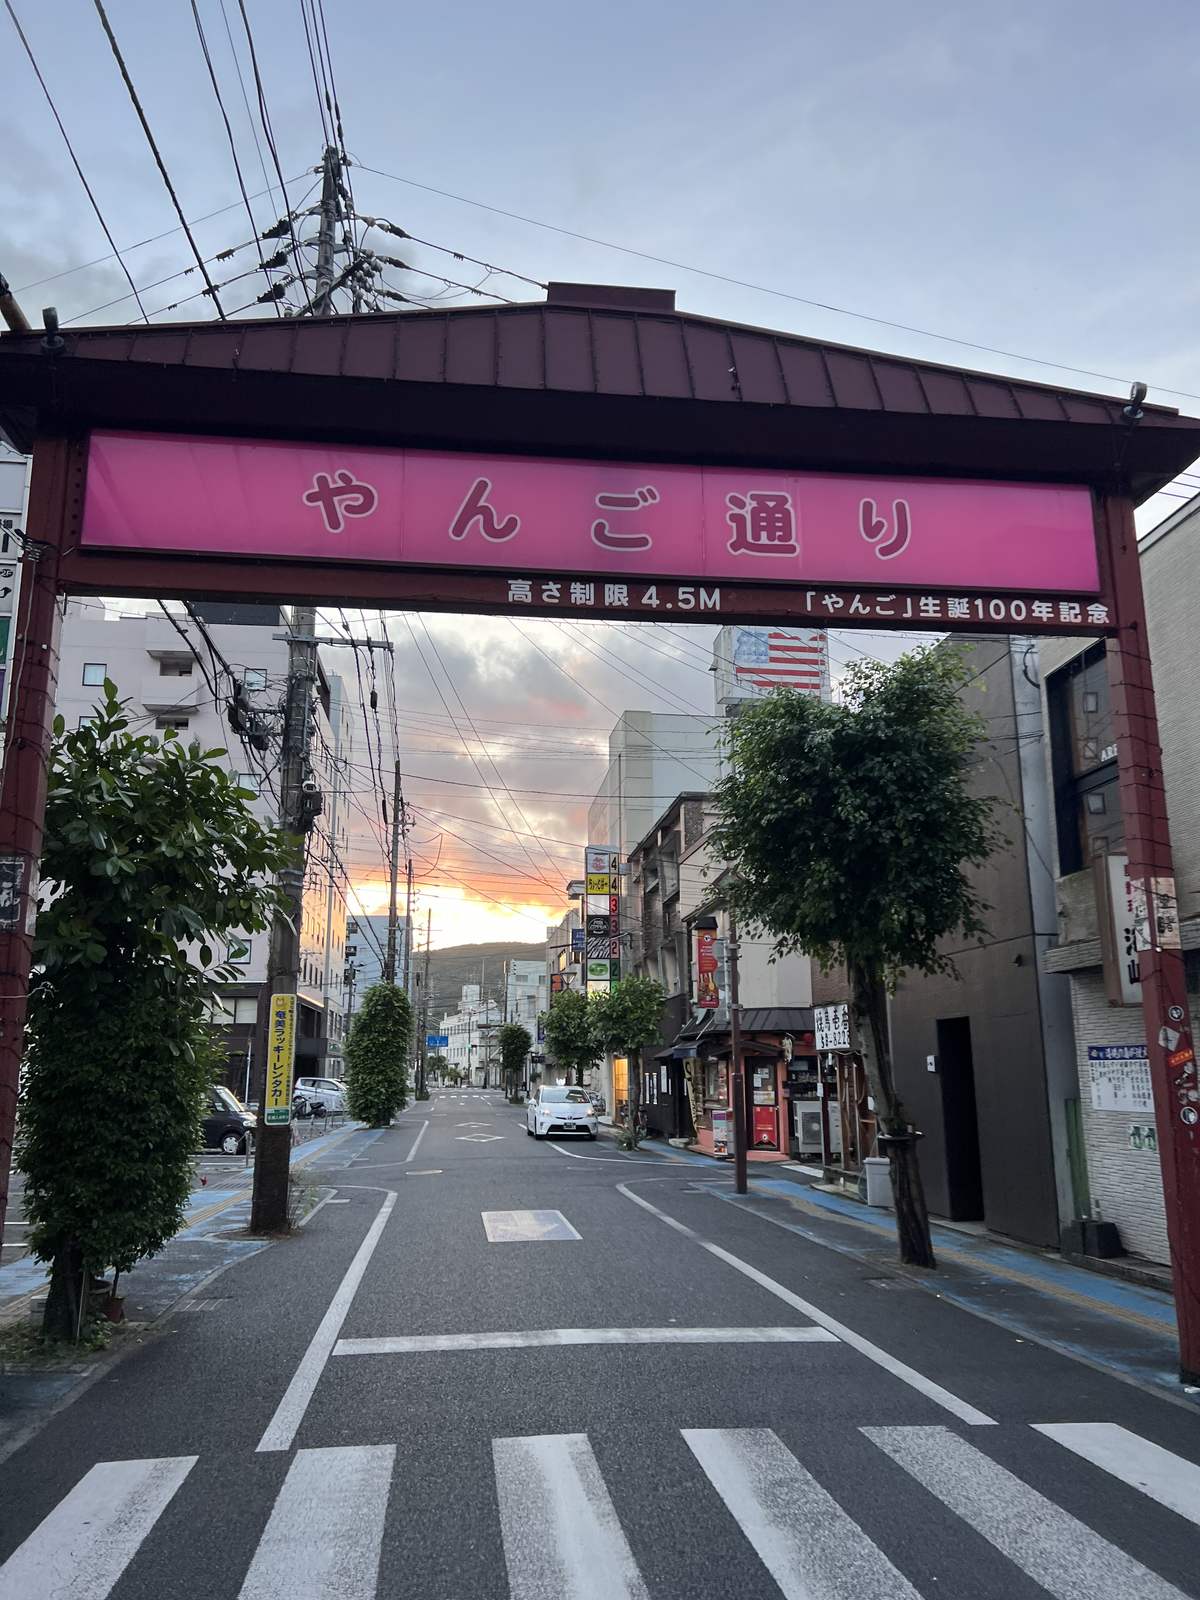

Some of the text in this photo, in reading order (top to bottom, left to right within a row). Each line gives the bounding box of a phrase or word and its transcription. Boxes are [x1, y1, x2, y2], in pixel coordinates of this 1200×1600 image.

[304, 471, 911, 559] やんご通り
[507, 579, 721, 611] 高さ制限4.5M
[805, 591, 1110, 624] 「やんご」生誕100年記念
[611, 856, 617, 870] 4
[611, 877, 617, 891] 4
[611, 898, 617, 913] 3
[611, 941, 618, 954] 2
